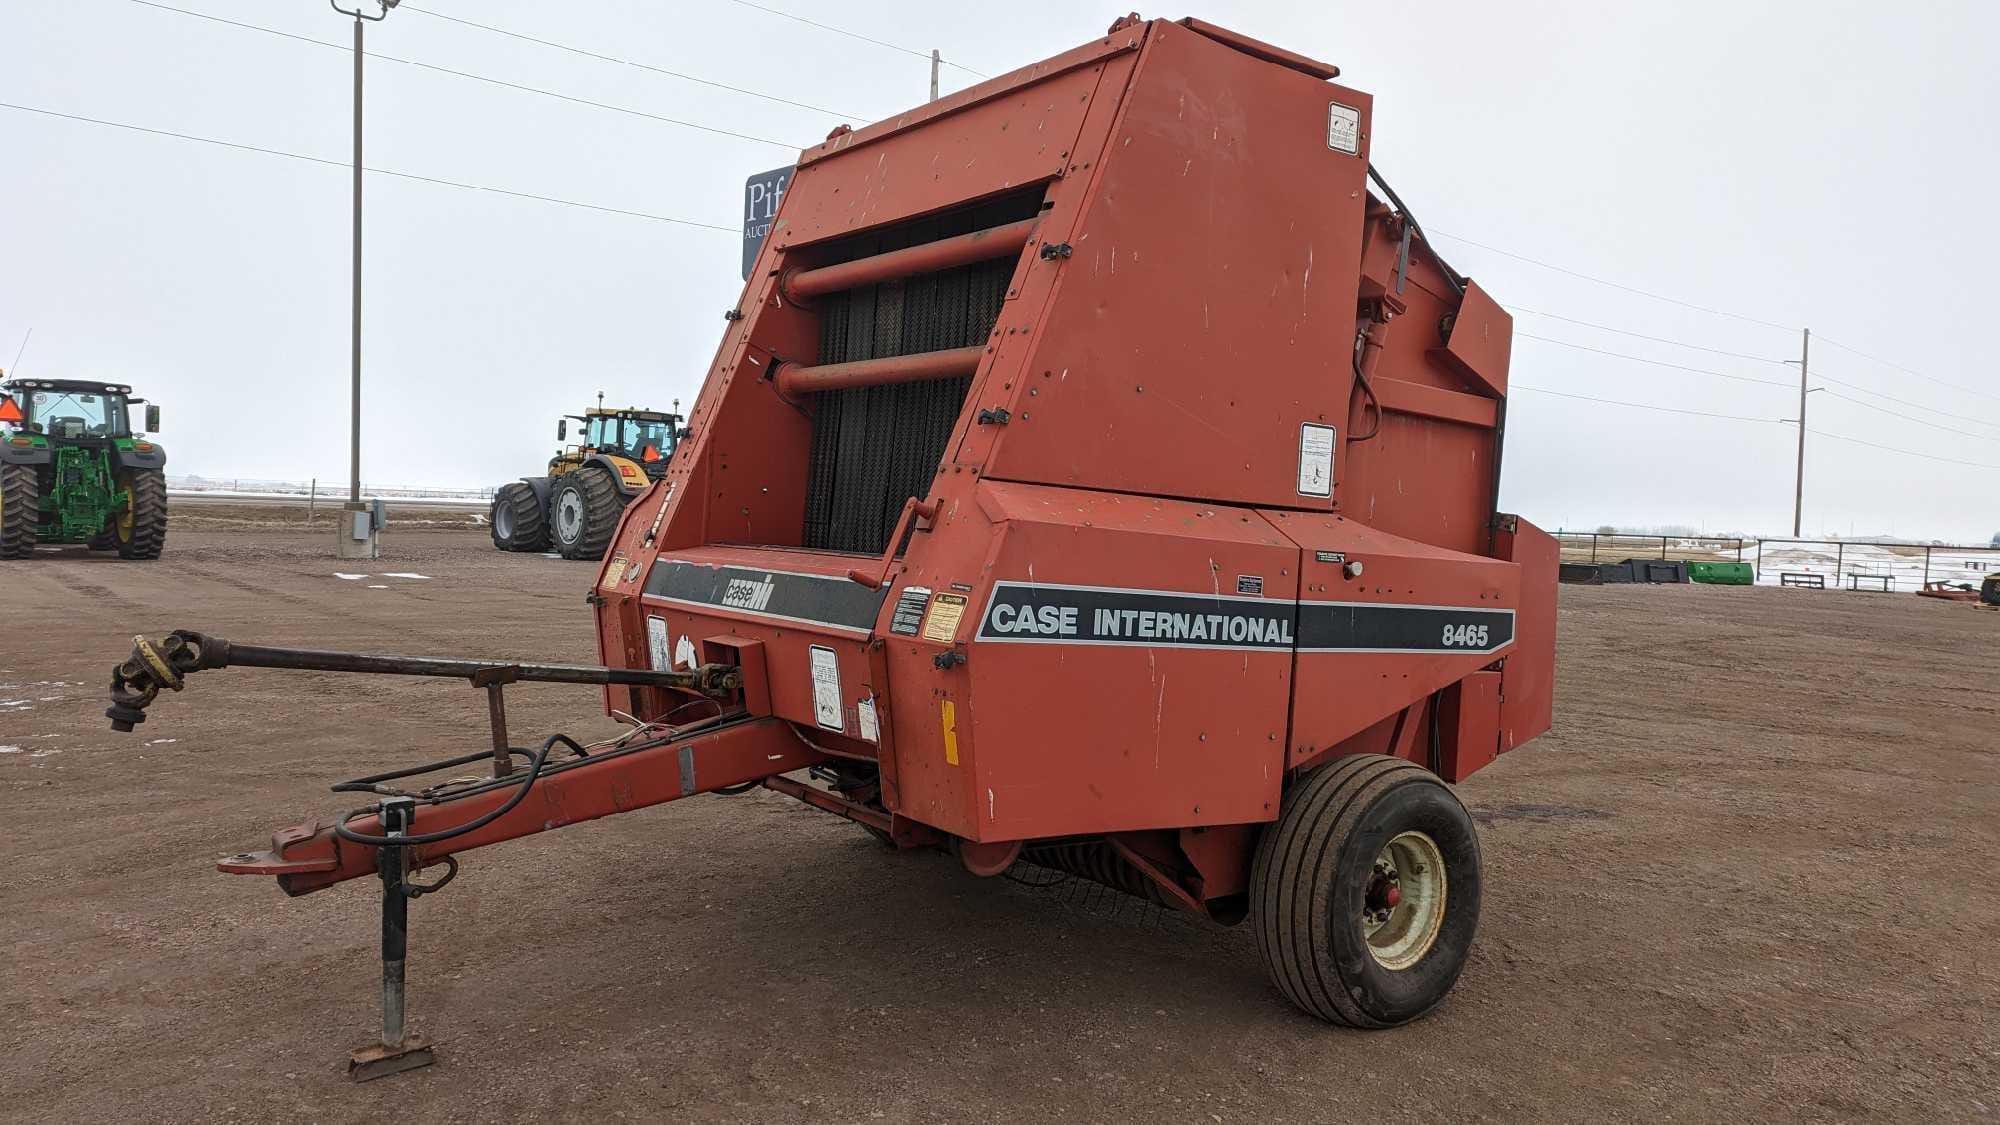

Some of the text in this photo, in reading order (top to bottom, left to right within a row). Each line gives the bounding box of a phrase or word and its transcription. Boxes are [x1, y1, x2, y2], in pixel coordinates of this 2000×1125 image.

[991, 603, 1078, 635] CASE
[1093, 608, 1294, 644] INTERNATIONAL
[1441, 624, 1489, 647] 8465
